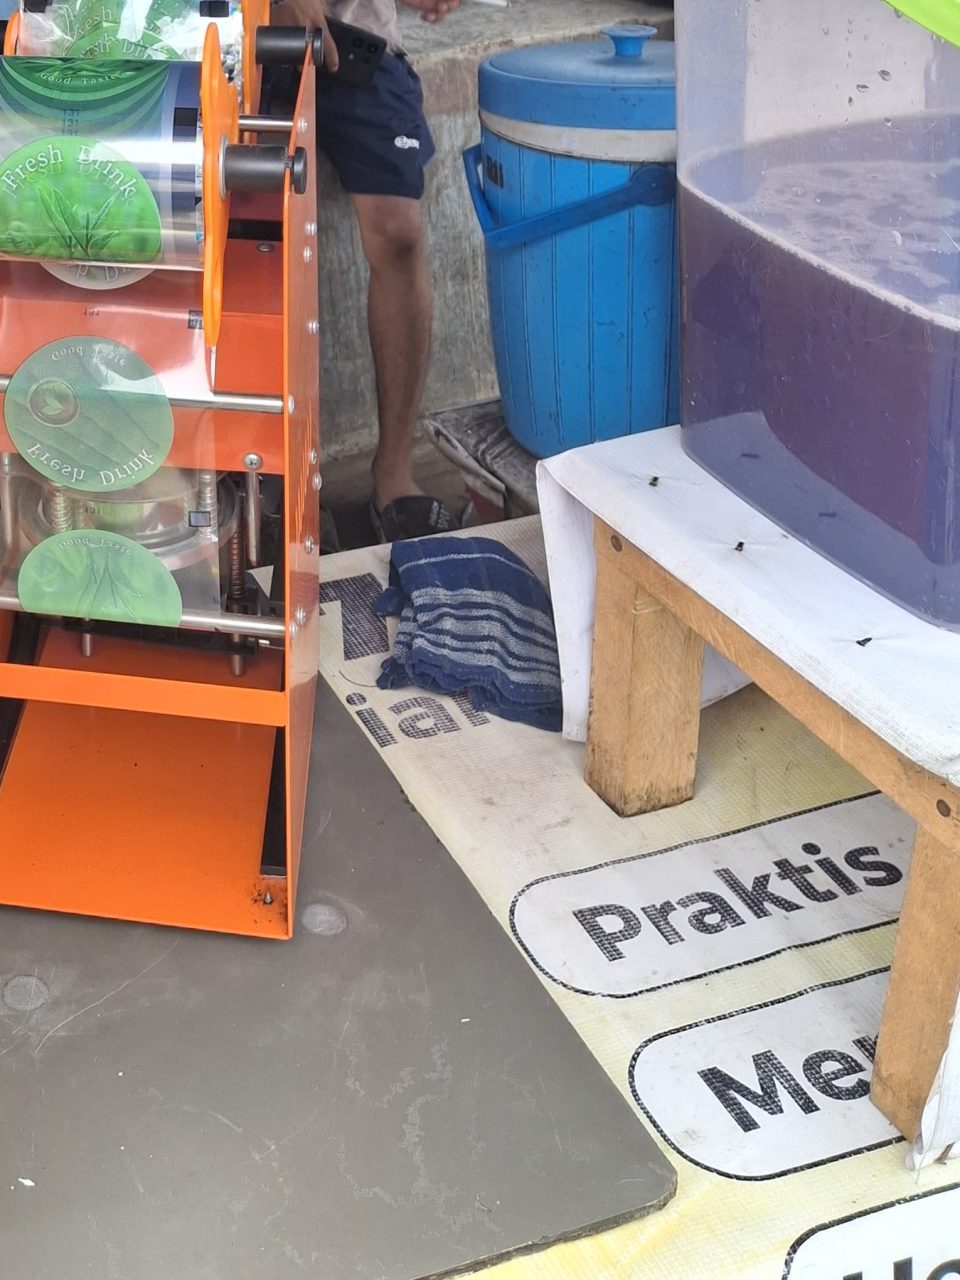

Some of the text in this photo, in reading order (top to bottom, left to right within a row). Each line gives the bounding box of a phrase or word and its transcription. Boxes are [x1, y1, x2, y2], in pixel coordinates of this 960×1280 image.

[40, 71, 73, 85] Good
[1, 143, 138, 198] Fresh Drink
[572, 841, 904, 963] Praktis
